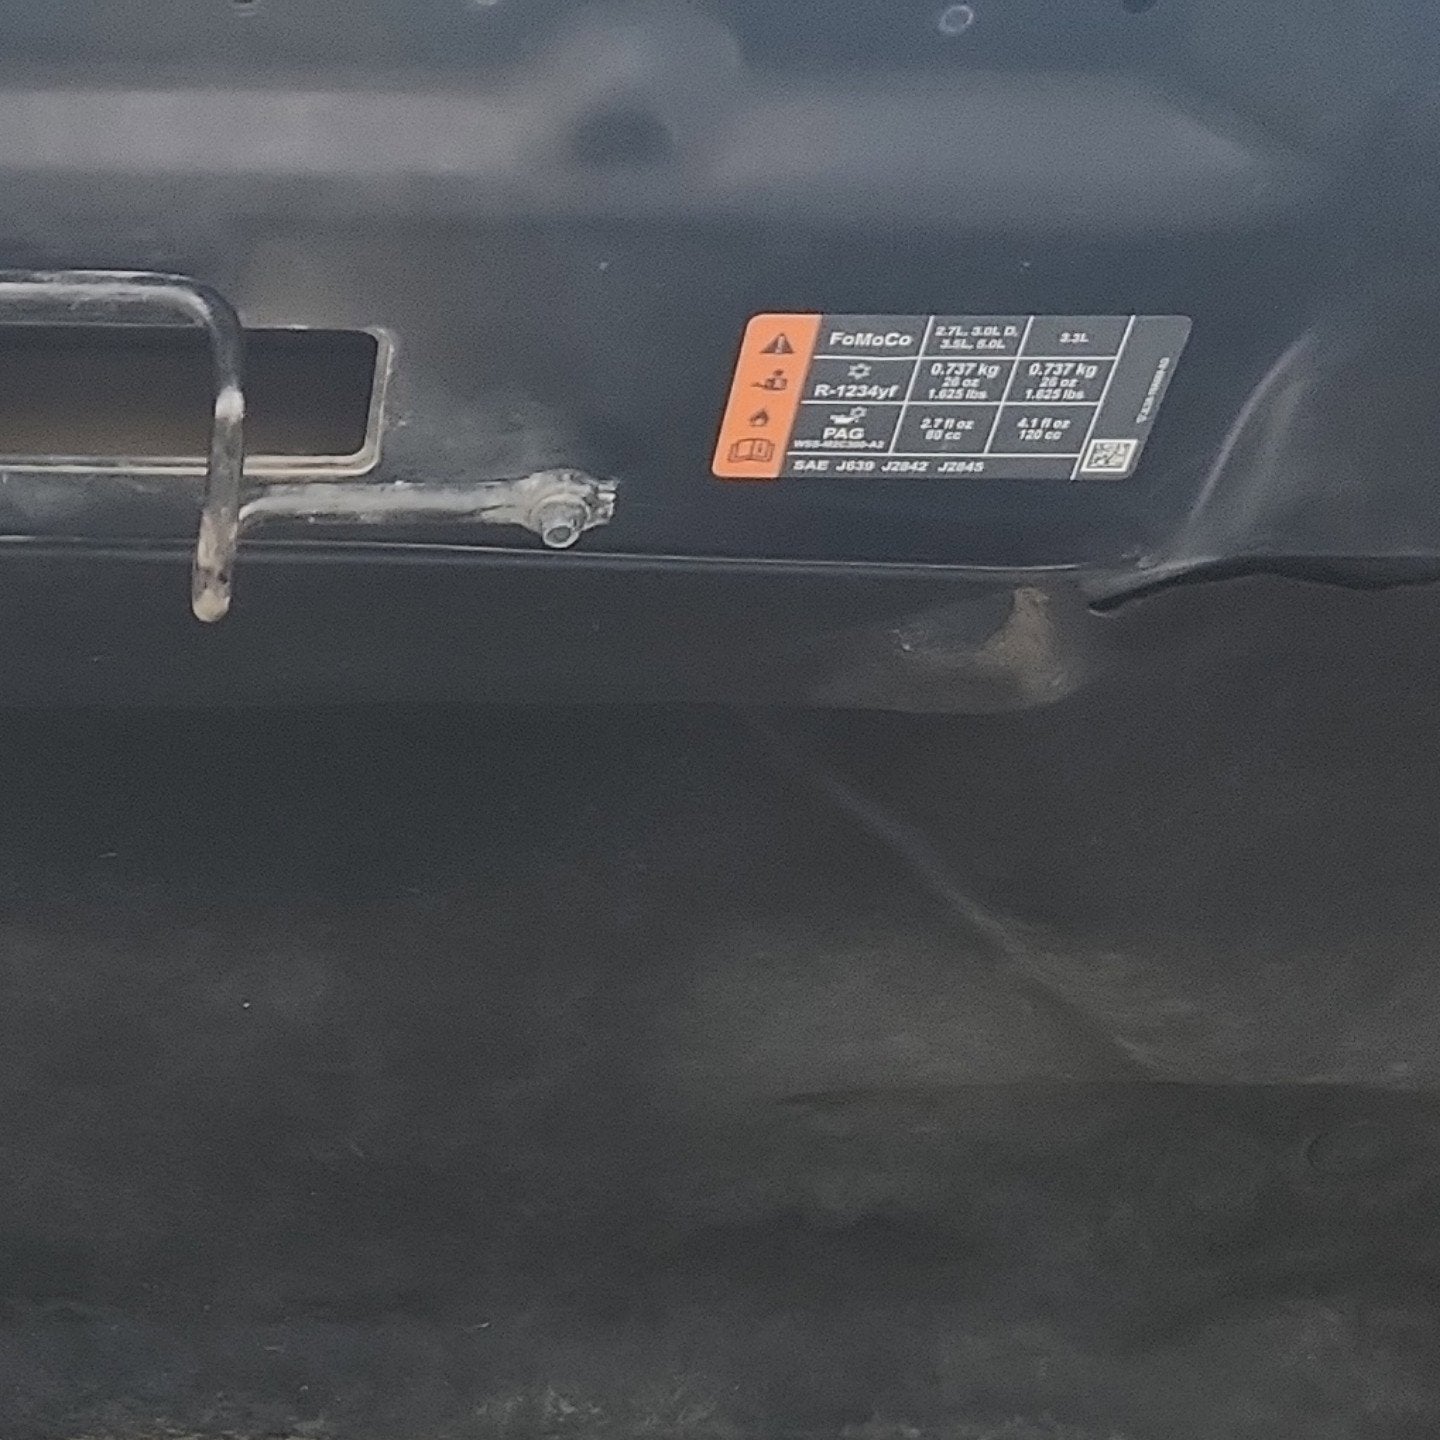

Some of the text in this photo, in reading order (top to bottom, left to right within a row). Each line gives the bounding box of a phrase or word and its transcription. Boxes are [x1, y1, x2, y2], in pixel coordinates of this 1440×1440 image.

[935, 326, 969, 337] 2.7L,
[971, 326, 1001, 337] 3.0L
[829, 332, 912, 347] FoMoCo
[1060, 332, 1090, 343] 3.3L
[976, 339, 1006, 349] 5.0L
[931, 363, 1000, 379] 0.737 kg
[1028, 363, 1098, 379] 0.737 kg
[942, 376, 981, 387] 26 oz
[1039, 377, 1079, 387] 26 oz
[814, 384, 899, 400] R-1234yf
[928, 388, 988, 399] 1.625 lbs
[1025, 388, 1085, 399] 1.625 lbs
[920, 417, 975, 429] 2.7 fl oz
[1017, 417, 1071, 429] 4.1 fl oz
[823, 427, 865, 440] PAG
[944, 431, 962, 440] cc
[1019, 429, 1063, 440] 120 cc
[793, 460, 984, 473] SAE J639 J2842 J2845
